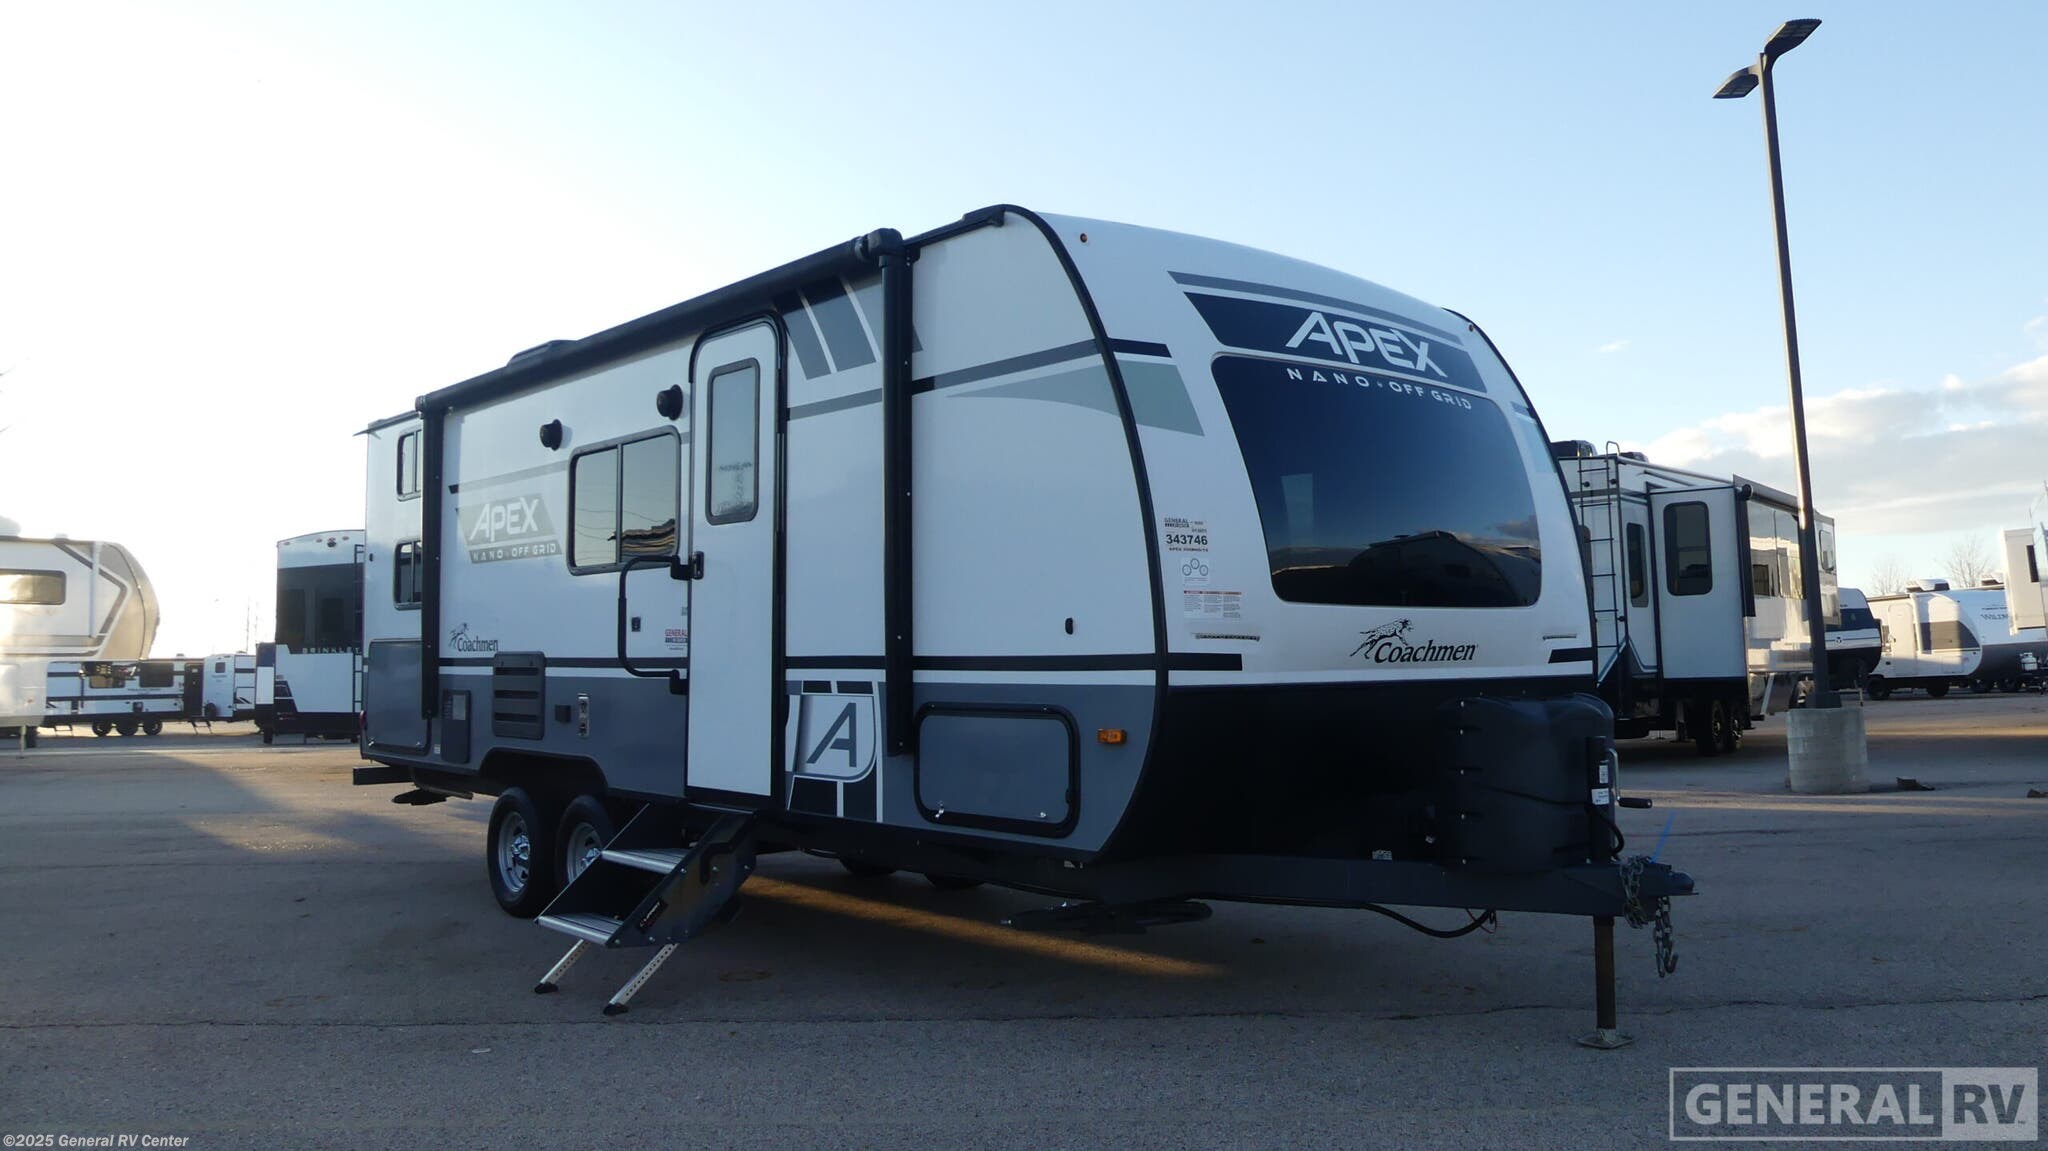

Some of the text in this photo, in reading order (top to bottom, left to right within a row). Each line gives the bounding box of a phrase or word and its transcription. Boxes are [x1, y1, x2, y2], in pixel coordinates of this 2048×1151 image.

[1286, 312, 1448, 378] APEX
[1287, 368, 1472, 410] NANO OFF GRID
[468, 497, 539, 542] APEX
[473, 543, 557, 561] NANO OFF GRID
[1166, 534, 1208, 546] 343746
[457, 635, 499, 652] Coachmen
[1374, 640, 1477, 664] Coachmen
